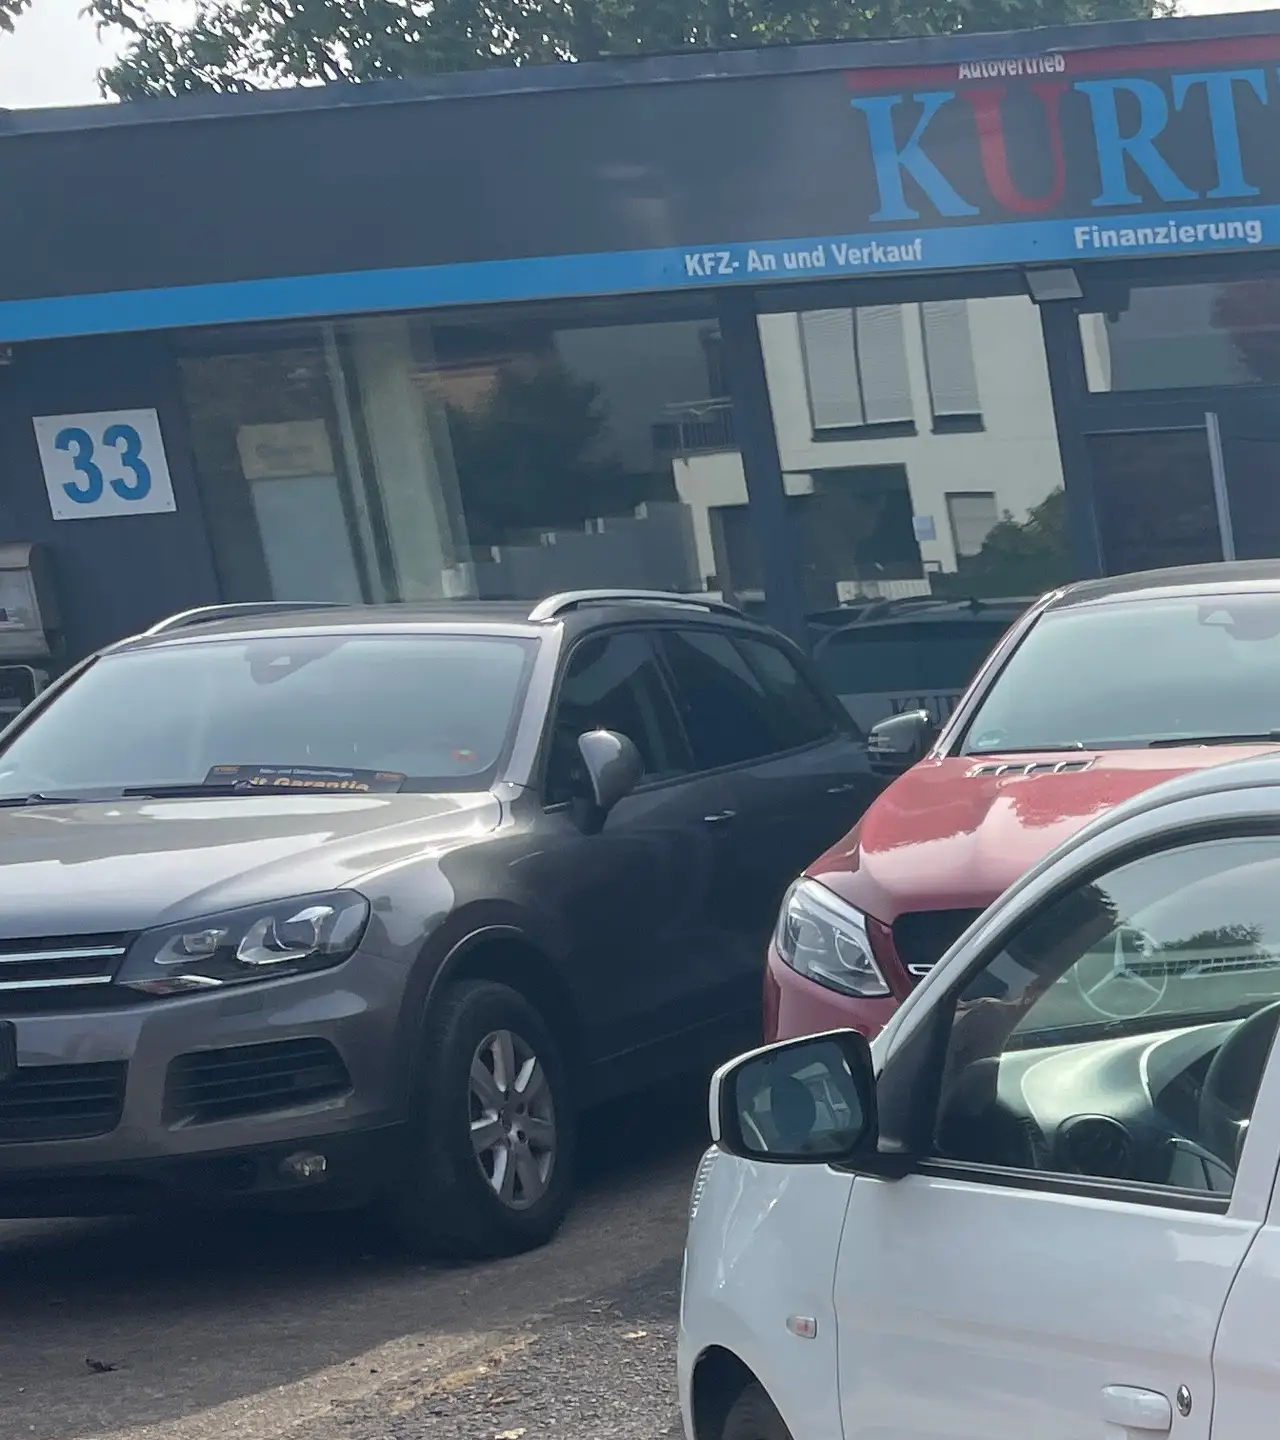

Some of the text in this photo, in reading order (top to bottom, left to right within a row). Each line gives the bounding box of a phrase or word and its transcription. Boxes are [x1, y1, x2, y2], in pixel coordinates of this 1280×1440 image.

[958, 53, 1066, 80] Autovertrieb
[1074, 219, 1263, 250] Finanzierung
[685, 238, 922, 277] KFZ- An und Verkauf
[54, 424, 152, 504] 33
